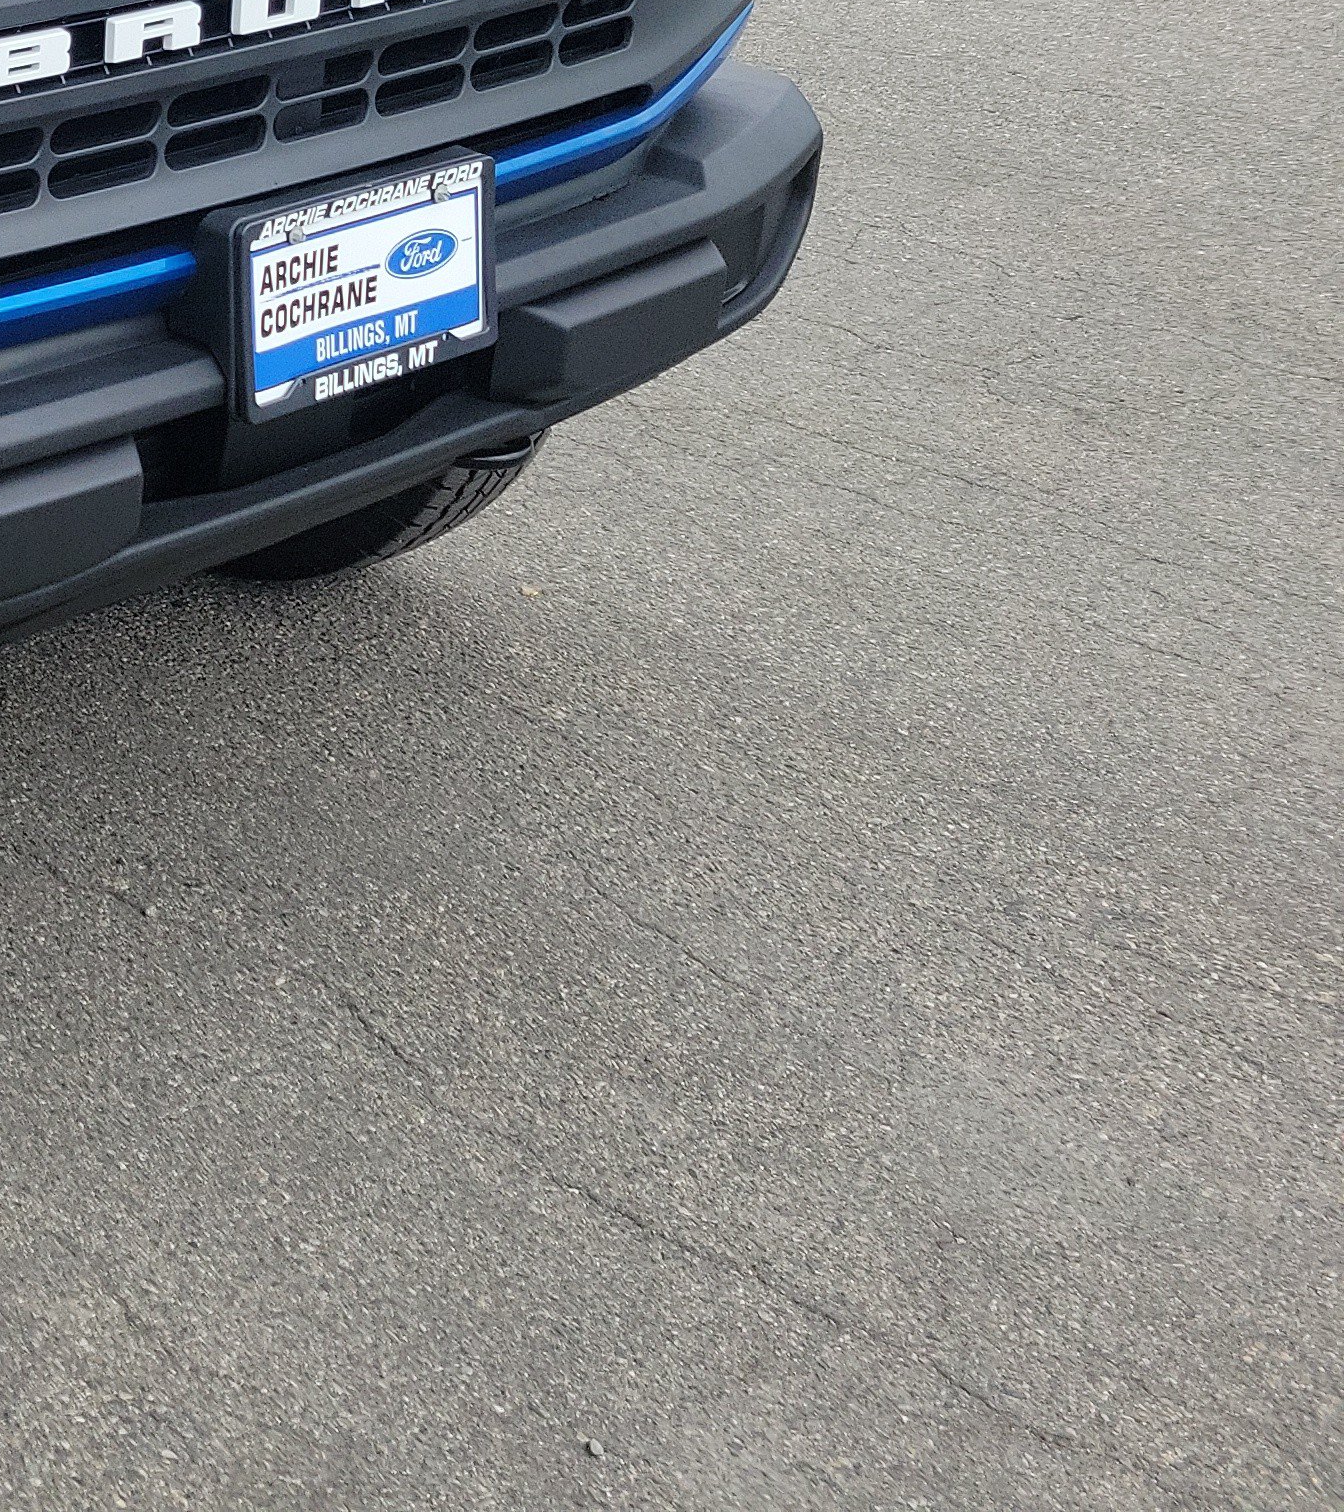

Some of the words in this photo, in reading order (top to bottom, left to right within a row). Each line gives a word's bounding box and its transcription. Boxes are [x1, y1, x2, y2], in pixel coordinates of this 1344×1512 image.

[259, 202, 329, 241] ARCHIE
[329, 175, 431, 218] COCHRANE
[431, 161, 484, 191] FORD
[259, 244, 340, 296] ARCHIE
[400, 236, 443, 272] Ford
[260, 274, 379, 338] COCHRANE
[316, 319, 391, 363] BILLINGS,
[394, 310, 419, 338] MT
[314, 350, 404, 402] BILLINGS,
[408, 340, 439, 370] MT
